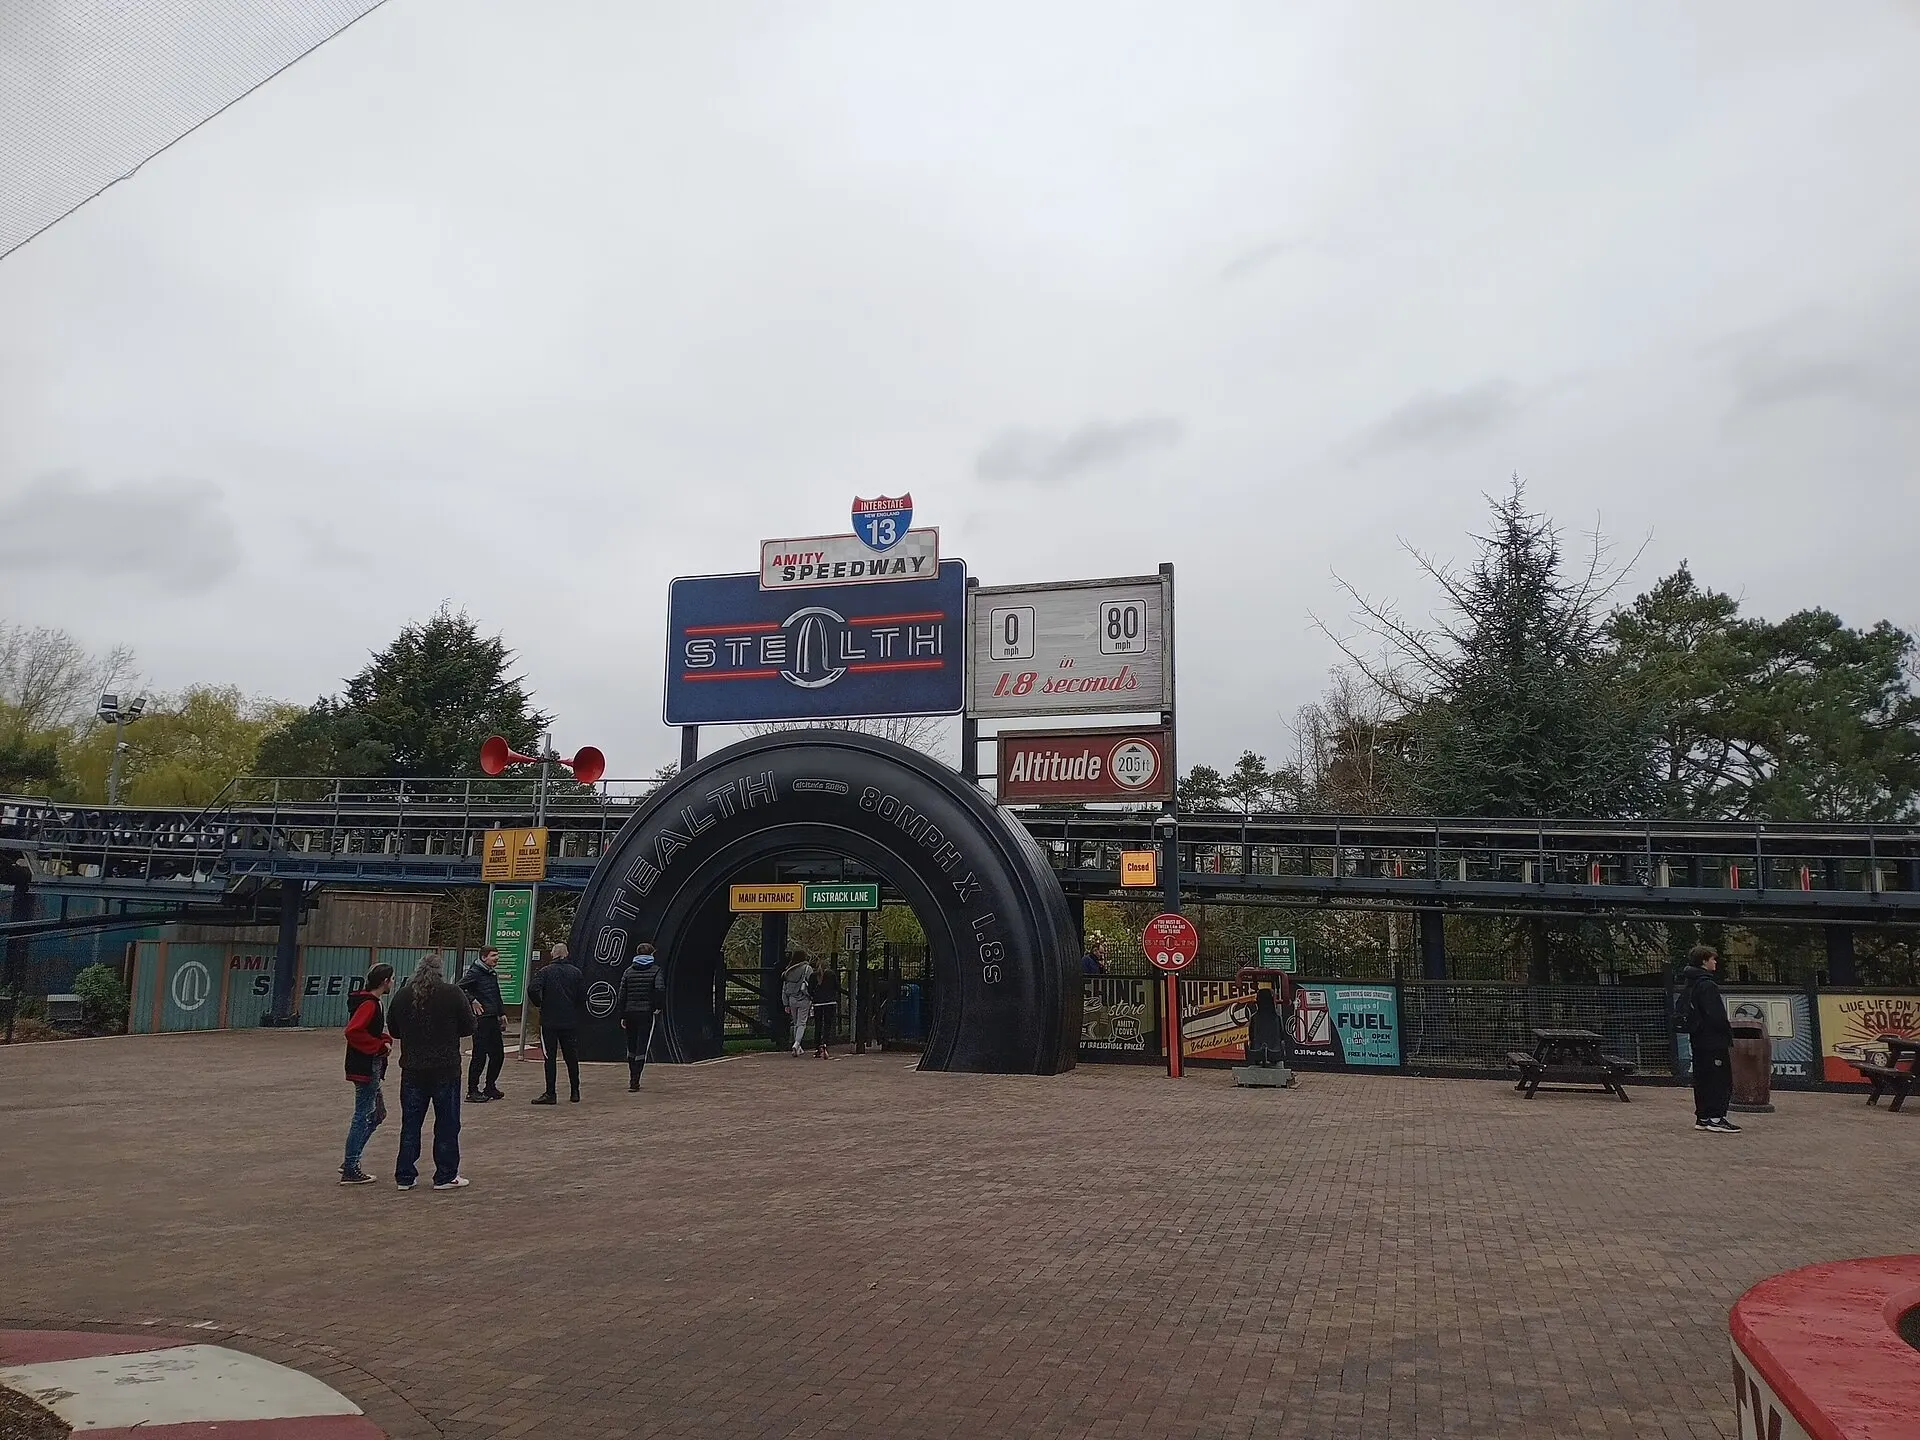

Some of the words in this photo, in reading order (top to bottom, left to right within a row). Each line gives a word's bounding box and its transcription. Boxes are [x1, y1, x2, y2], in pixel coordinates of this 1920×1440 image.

[860, 498, 904, 512] INTERSTATE
[866, 519, 897, 546] 13
[772, 551, 825, 567] AMITY
[781, 555, 927, 582] SPEEDWAY
[1004, 613, 1019, 645] 0
[1107, 606, 1139, 640] 80
[684, 615, 943, 675] STEALTH
[1003, 645, 1019, 657] mph
[1115, 640, 1131, 652] mph
[1058, 655, 1076, 669] in
[993, 670, 1039, 698] 1.8
[1037, 664, 1142, 694] seconds
[1009, 749, 1102, 782] Altitude
[858, 786, 963, 873] 80MPH
[952, 871, 983, 903] X
[593, 770, 779, 966] STEALTH
[1127, 862, 1150, 872] Closed
[738, 892, 757, 903] MAIN
[758, 892, 795, 903] ENTRANCE
[812, 892, 849, 903] FASTRACK
[850, 891, 869, 902] LANE
[1108, 997, 1146, 1017] store
[1839, 1001, 1866, 1013] LIVE
[1867, 999, 1893, 1010] LIFE
[1895, 1000, 1911, 1011] ON
[1116, 1020, 1135, 1028] AMITY
[1337, 1013, 1393, 1030] FUEL
[1863, 1011, 1915, 1030] EDGE
[1119, 1027, 1134, 1036] COVE
